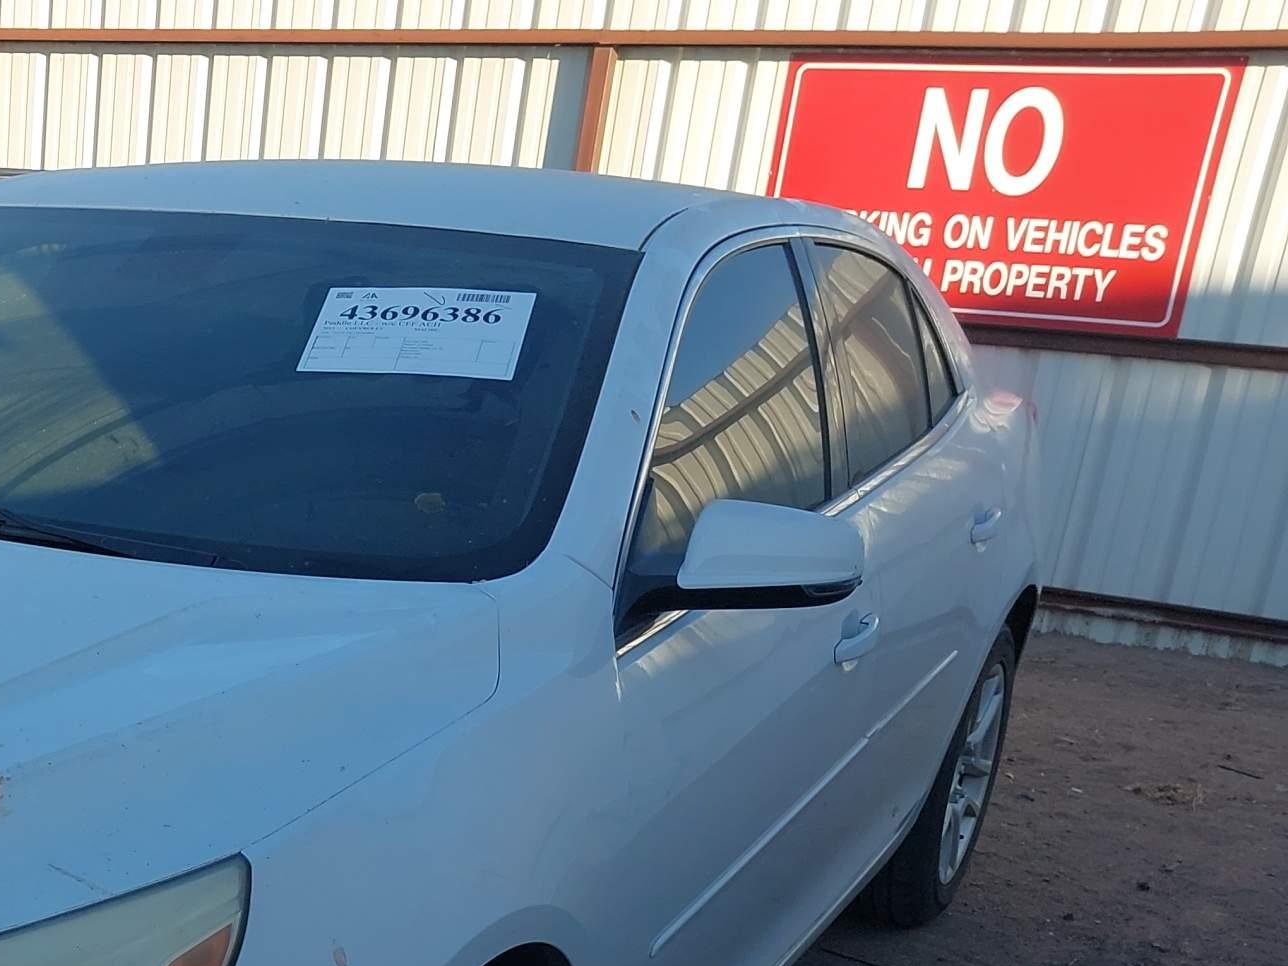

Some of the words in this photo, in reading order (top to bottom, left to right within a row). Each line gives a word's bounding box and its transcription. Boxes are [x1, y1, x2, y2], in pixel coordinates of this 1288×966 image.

[906, 86, 1064, 196] NO
[943, 213, 994, 250] ON
[1007, 217, 1169, 262] VEHICLES
[940, 258, 1117, 303] PROPERTY
[339, 304, 505, 325] 43696386
